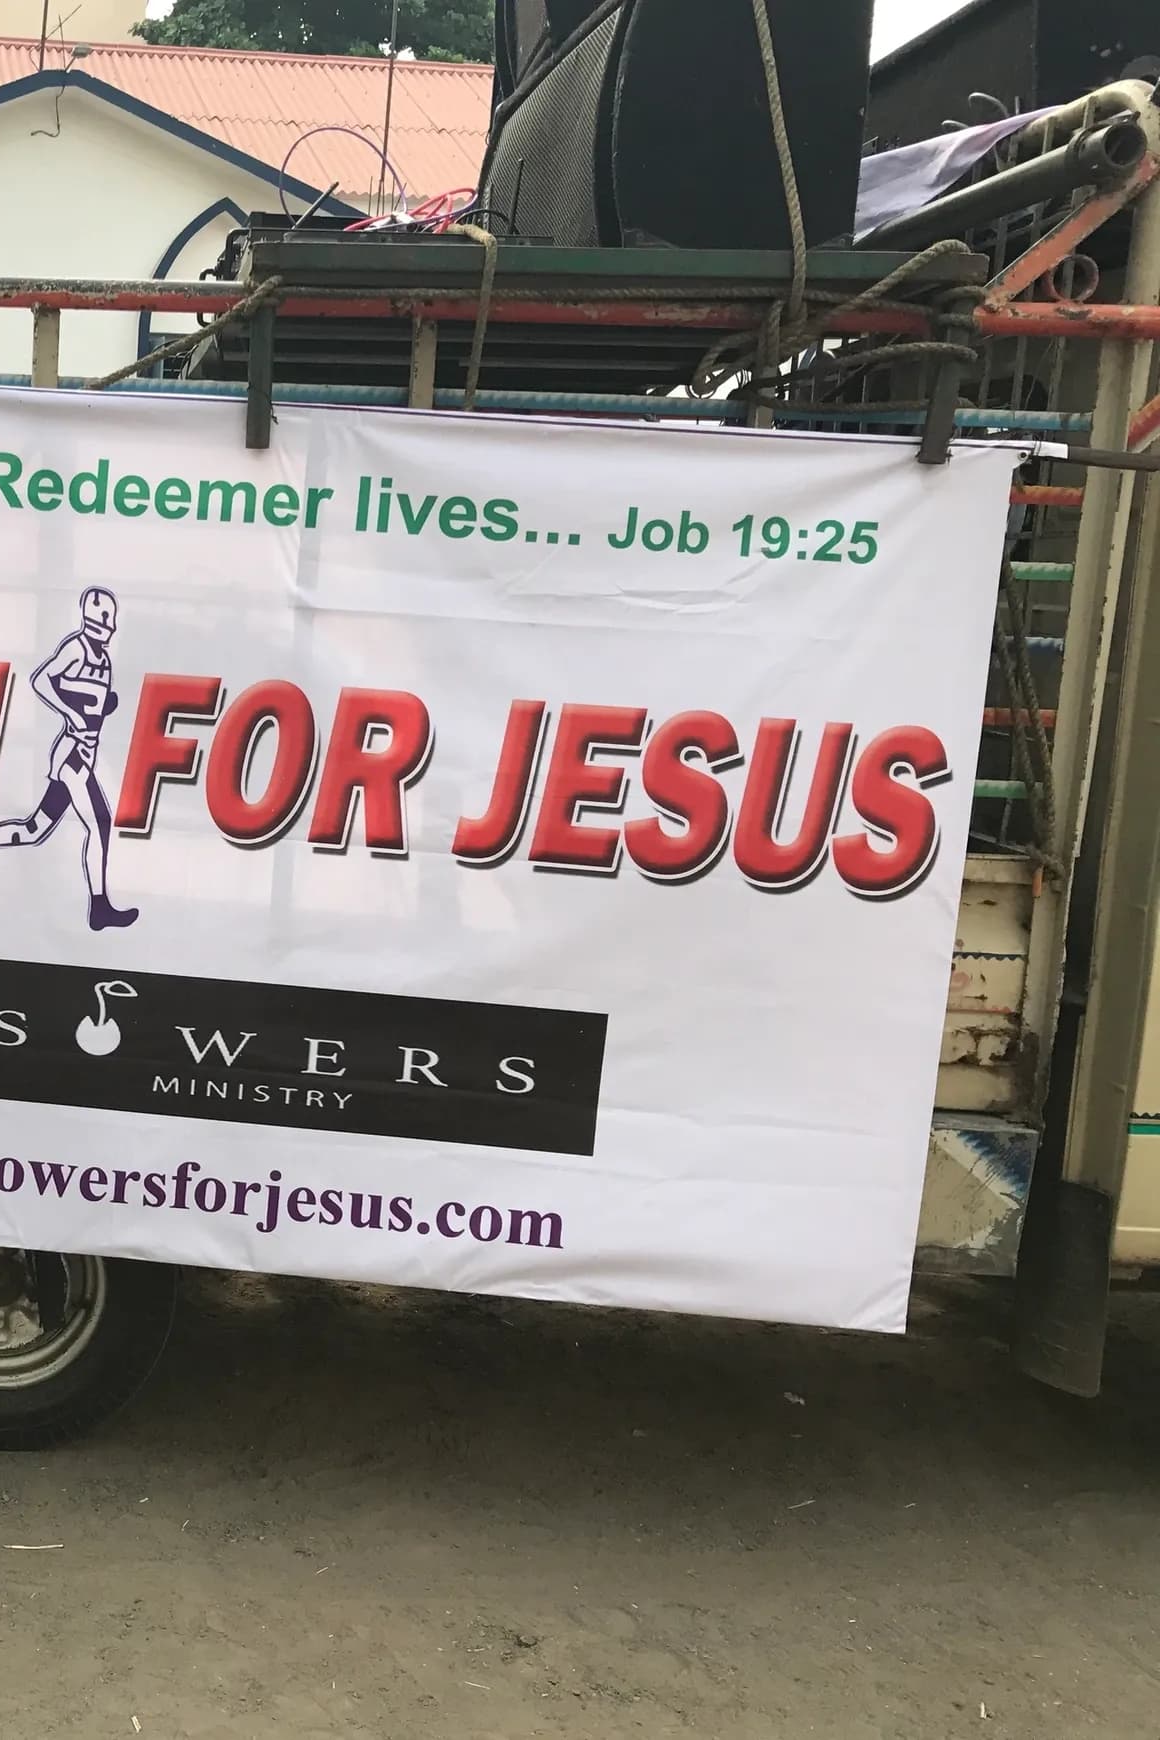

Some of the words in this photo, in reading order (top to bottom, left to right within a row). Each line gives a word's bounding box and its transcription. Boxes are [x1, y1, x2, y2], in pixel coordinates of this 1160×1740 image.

[355, 476, 580, 545] lives...
[607, 507, 709, 554] Job
[732, 515, 879, 565] 19:25
[114, 674, 435, 857] FOR
[452, 698, 953, 901] JESUS
[152, 1075, 353, 1110] MINISTRY
